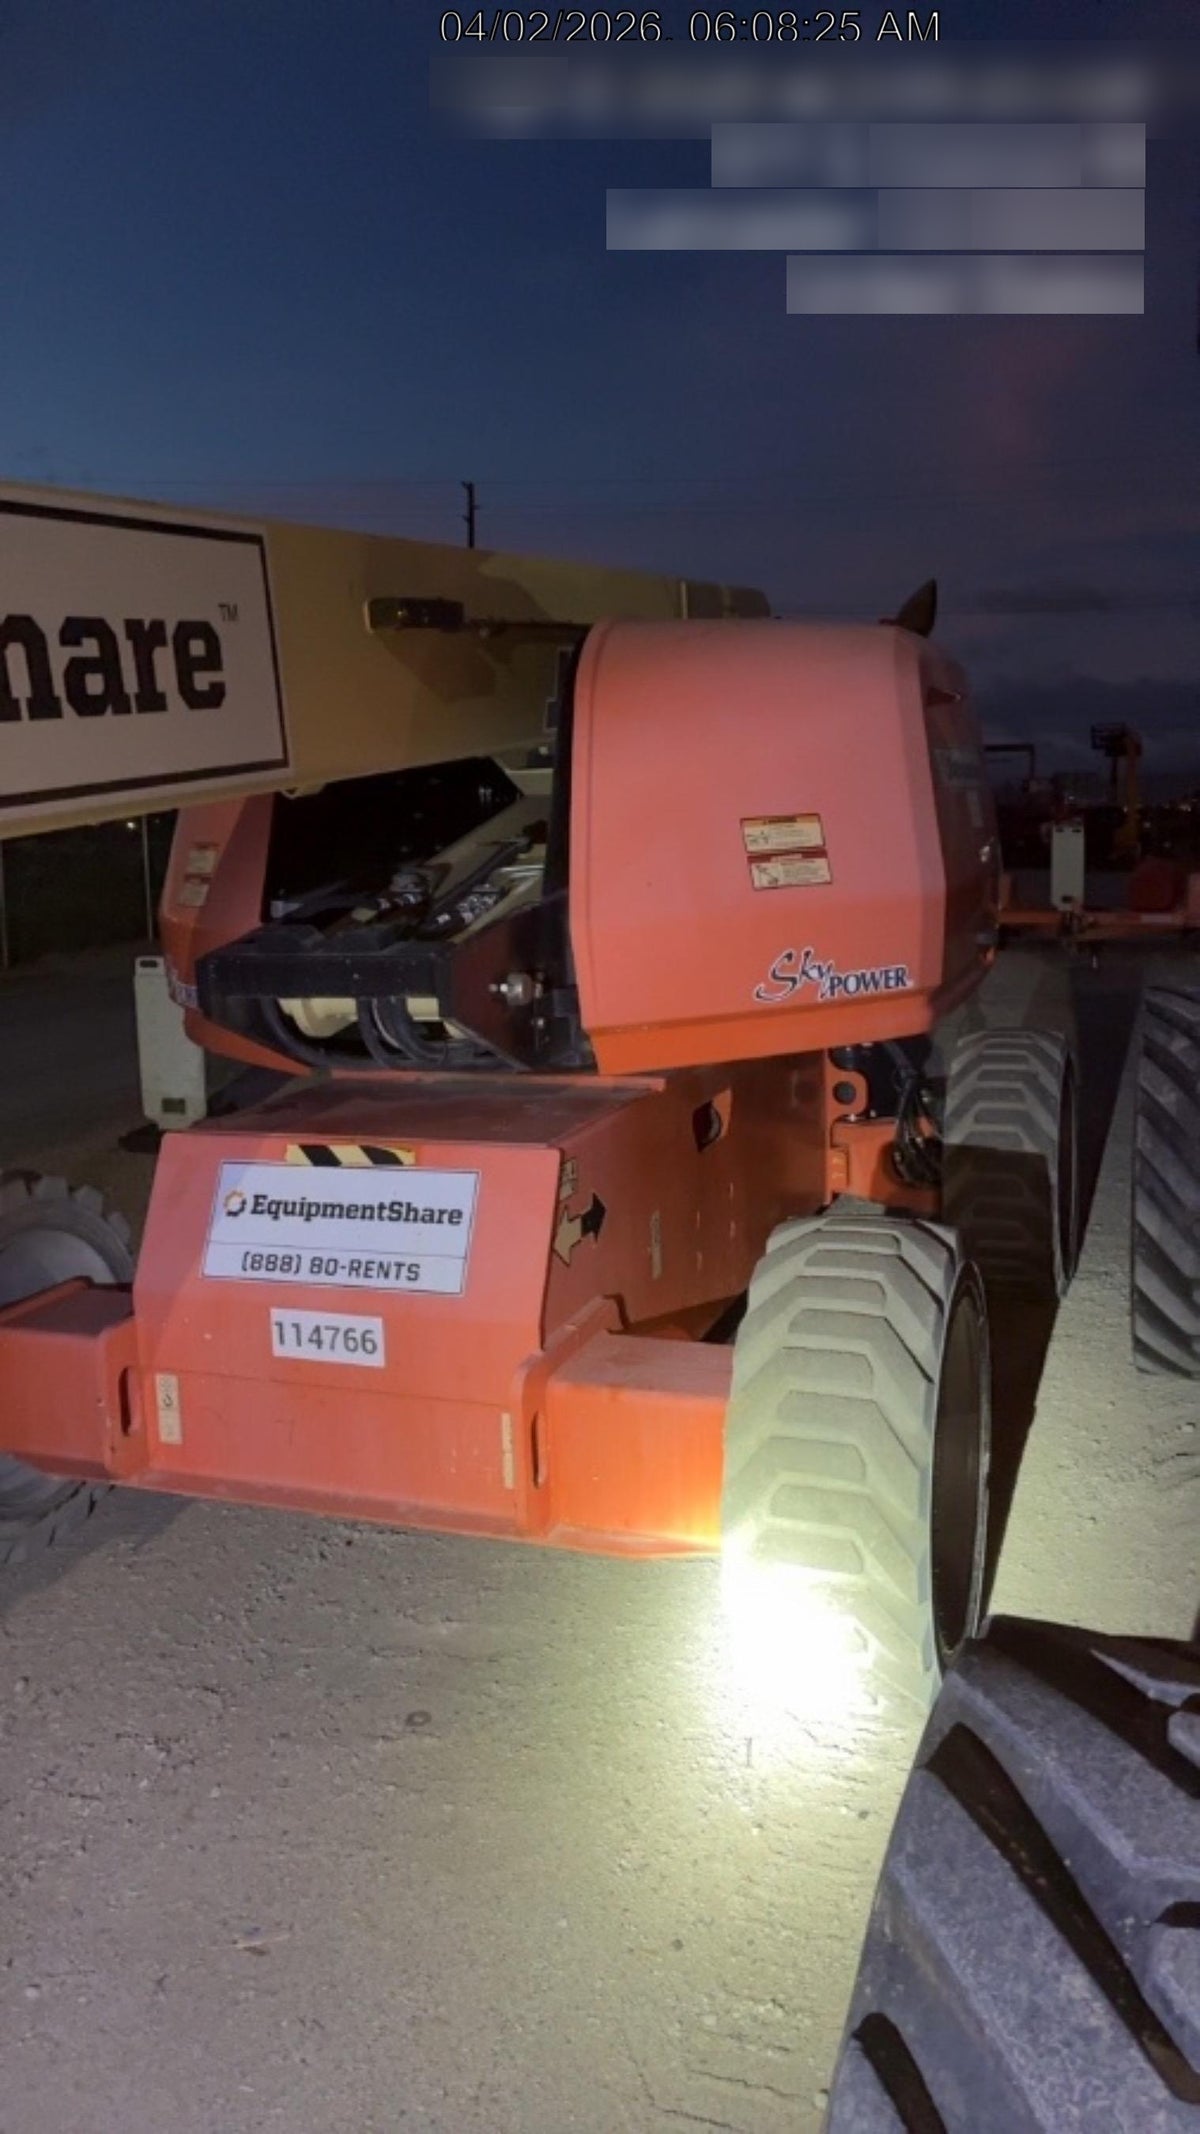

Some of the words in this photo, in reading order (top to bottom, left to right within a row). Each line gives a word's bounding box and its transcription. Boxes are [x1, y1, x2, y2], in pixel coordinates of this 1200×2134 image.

[755, 949, 833, 1001] Sky
[828, 964, 908, 997] POWER
[249, 1194, 464, 1225] EquipmentShare
[241, 1251, 302, 1274] (888)
[309, 1256, 421, 1282] 80-RENTS
[274, 1321, 378, 1355] 114766
